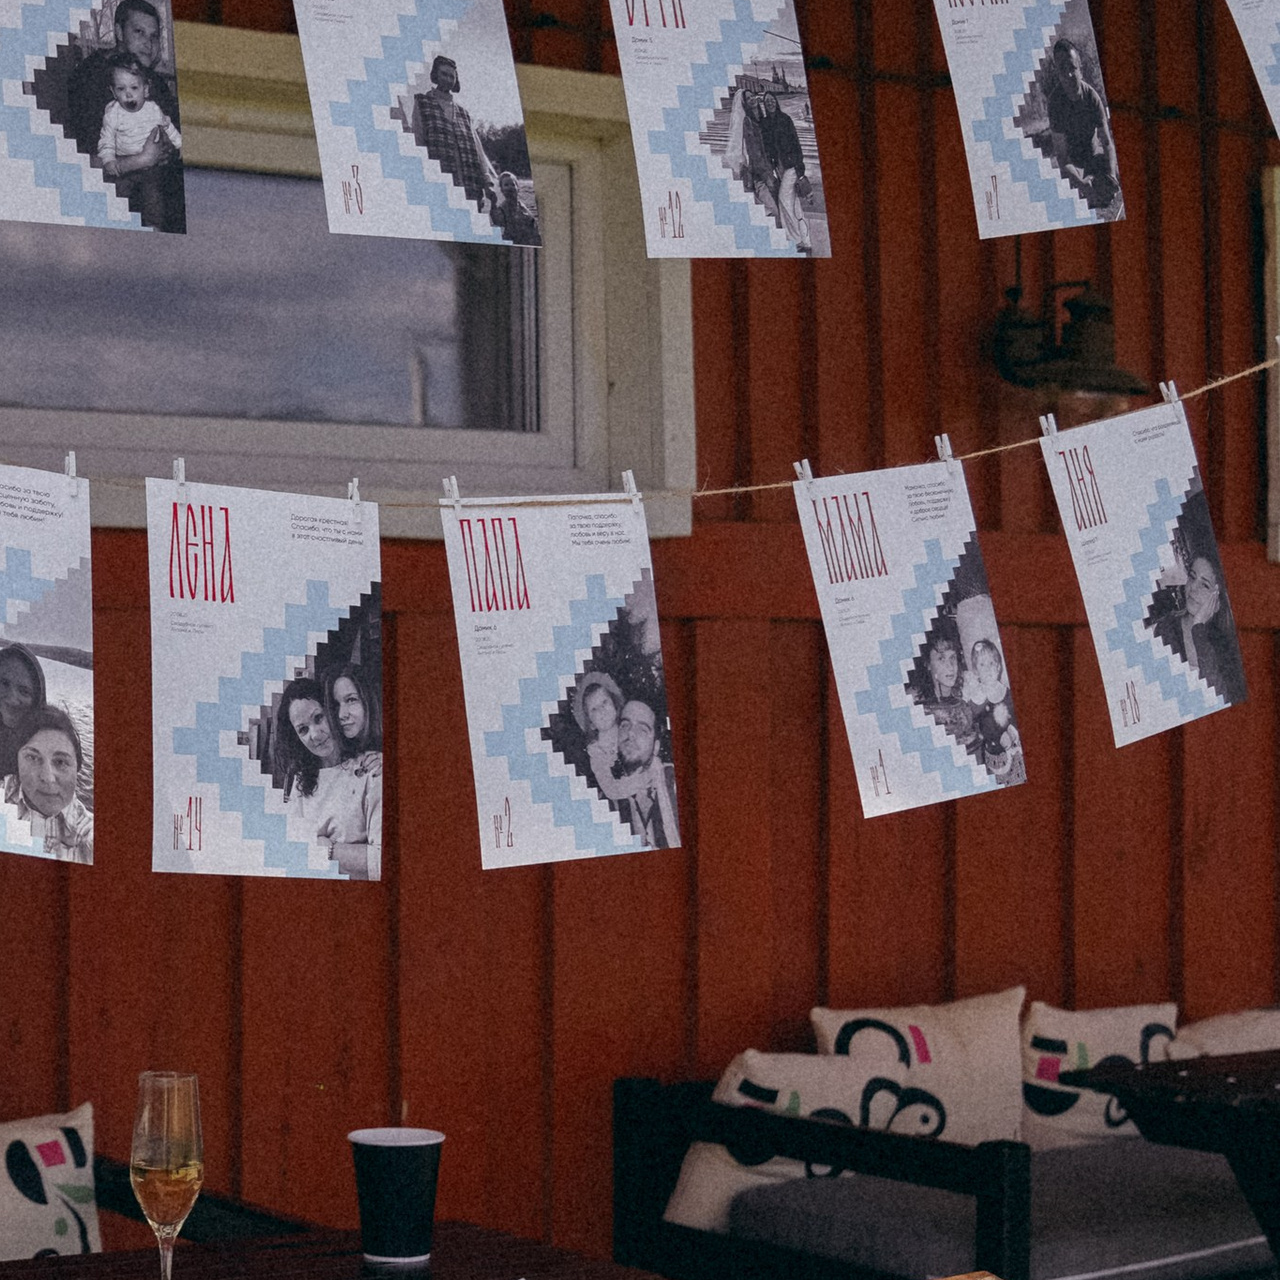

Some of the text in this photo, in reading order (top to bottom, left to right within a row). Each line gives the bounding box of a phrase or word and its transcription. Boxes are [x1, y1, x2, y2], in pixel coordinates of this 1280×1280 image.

[32, 489, 50, 498] твою
[1058, 445, 1108, 532] АНЯ
[30, 497, 55, 508] заботу,
[3, 509, 17, 518] тебя
[290, 513, 317, 523] Дорогая
[291, 522, 319, 532] Спасибо,
[310, 534, 346, 543] счастливый
[812, 491, 889, 584] МАМА
[169, 501, 236, 603] ЛЕНА
[459, 517, 531, 613] ПАПА
[473, 623, 492, 632] Домик
